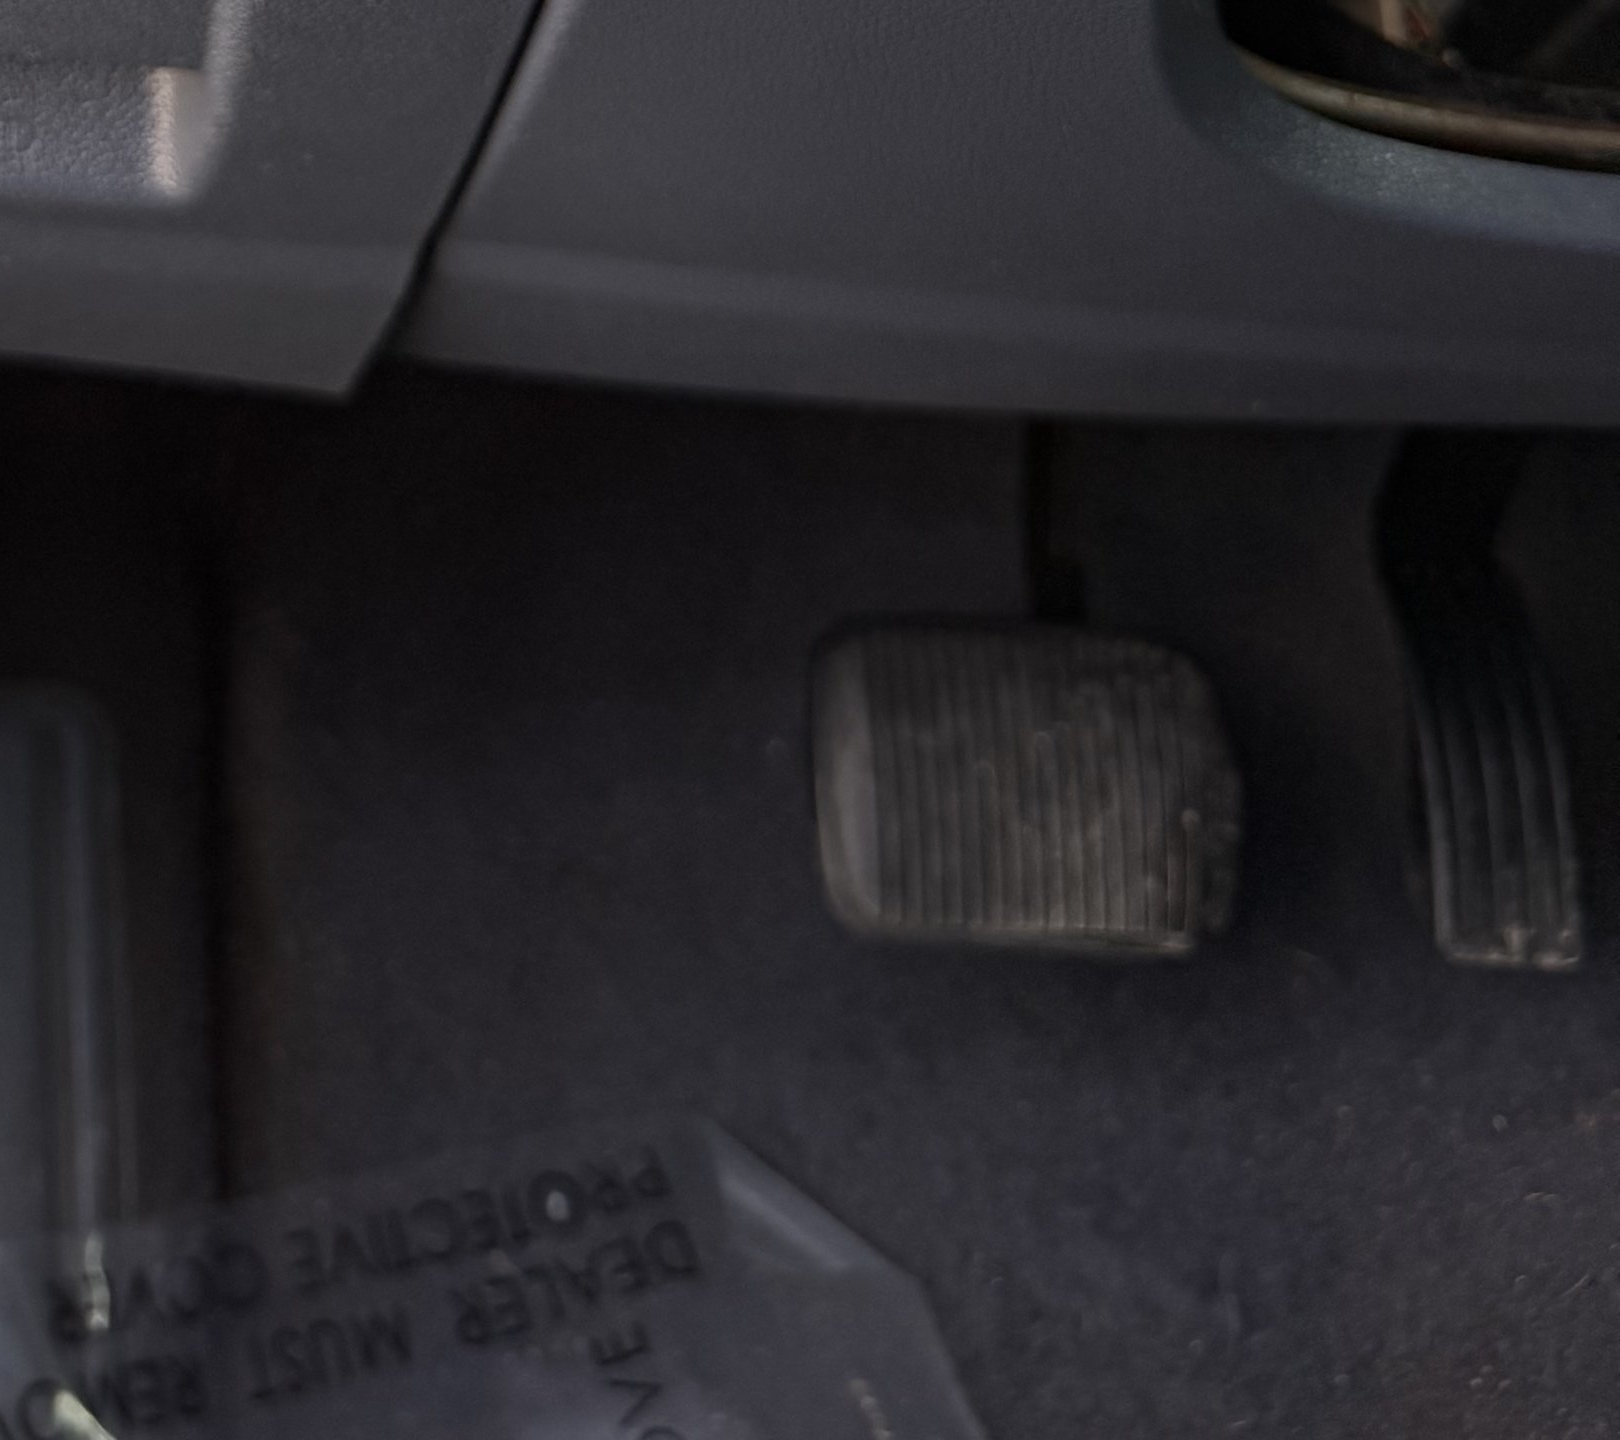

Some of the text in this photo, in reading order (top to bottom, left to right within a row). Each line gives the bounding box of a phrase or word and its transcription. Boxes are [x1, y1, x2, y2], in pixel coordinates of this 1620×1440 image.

[280, 1143, 674, 1297] PROTECTIVE
[447, 1219, 702, 1347] DEALER
[248, 1306, 414, 1401] MUST
